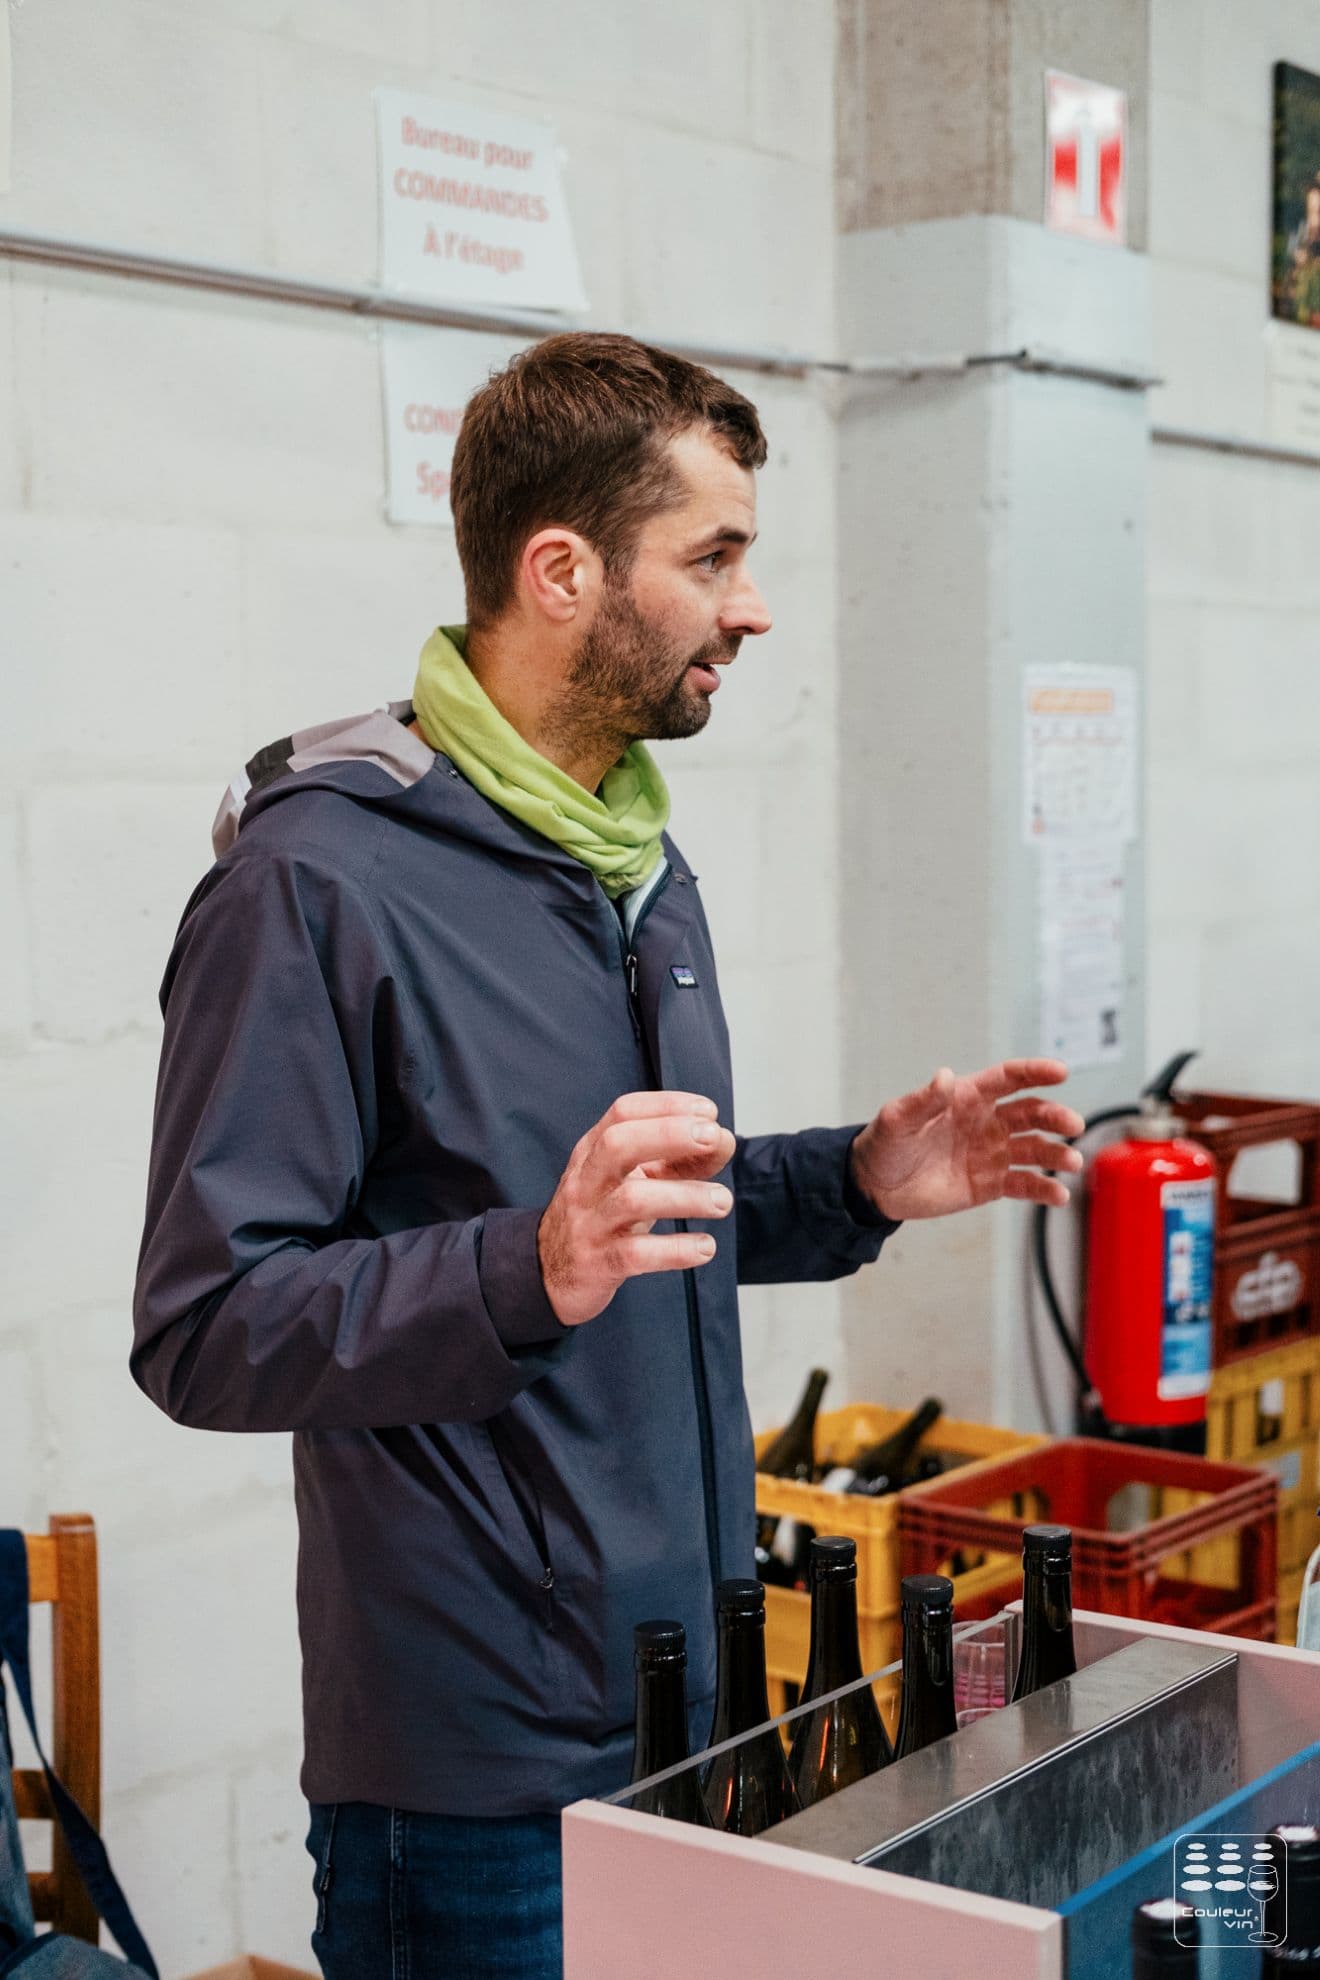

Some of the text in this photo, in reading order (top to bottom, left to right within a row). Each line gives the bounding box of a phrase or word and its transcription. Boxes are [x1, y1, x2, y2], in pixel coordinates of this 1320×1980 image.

[401, 117, 534, 168] Bureau pour
[394, 167, 549, 222] COMMANDES
[446, 231, 524, 274] l'étage
